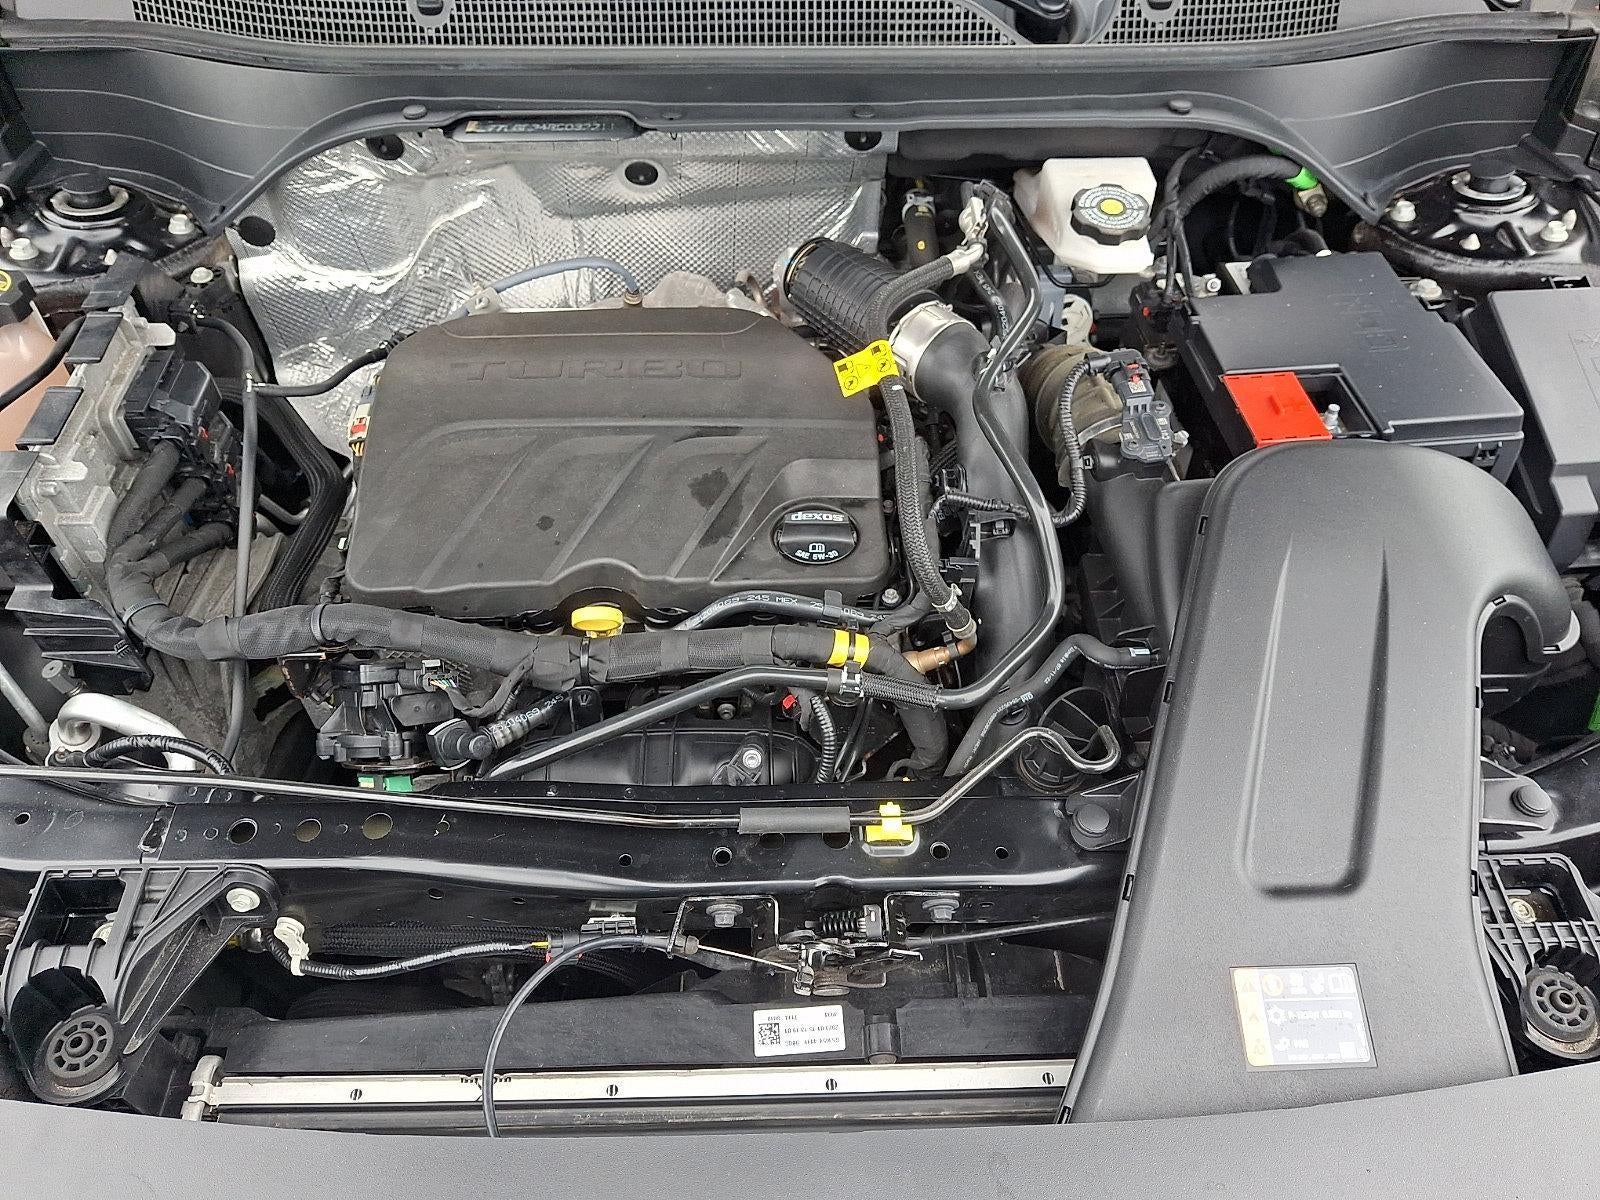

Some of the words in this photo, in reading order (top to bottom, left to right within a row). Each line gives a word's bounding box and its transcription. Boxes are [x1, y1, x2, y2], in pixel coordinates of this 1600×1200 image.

[450, 359, 742, 380] TURBO
[791, 511, 844, 522] dexos
[795, 549, 811, 560] SAE
[812, 550, 839, 561] 5W-30
[746, 594, 770, 602] 245
[775, 596, 798, 605] MEX
[544, 694, 564, 708] 245
